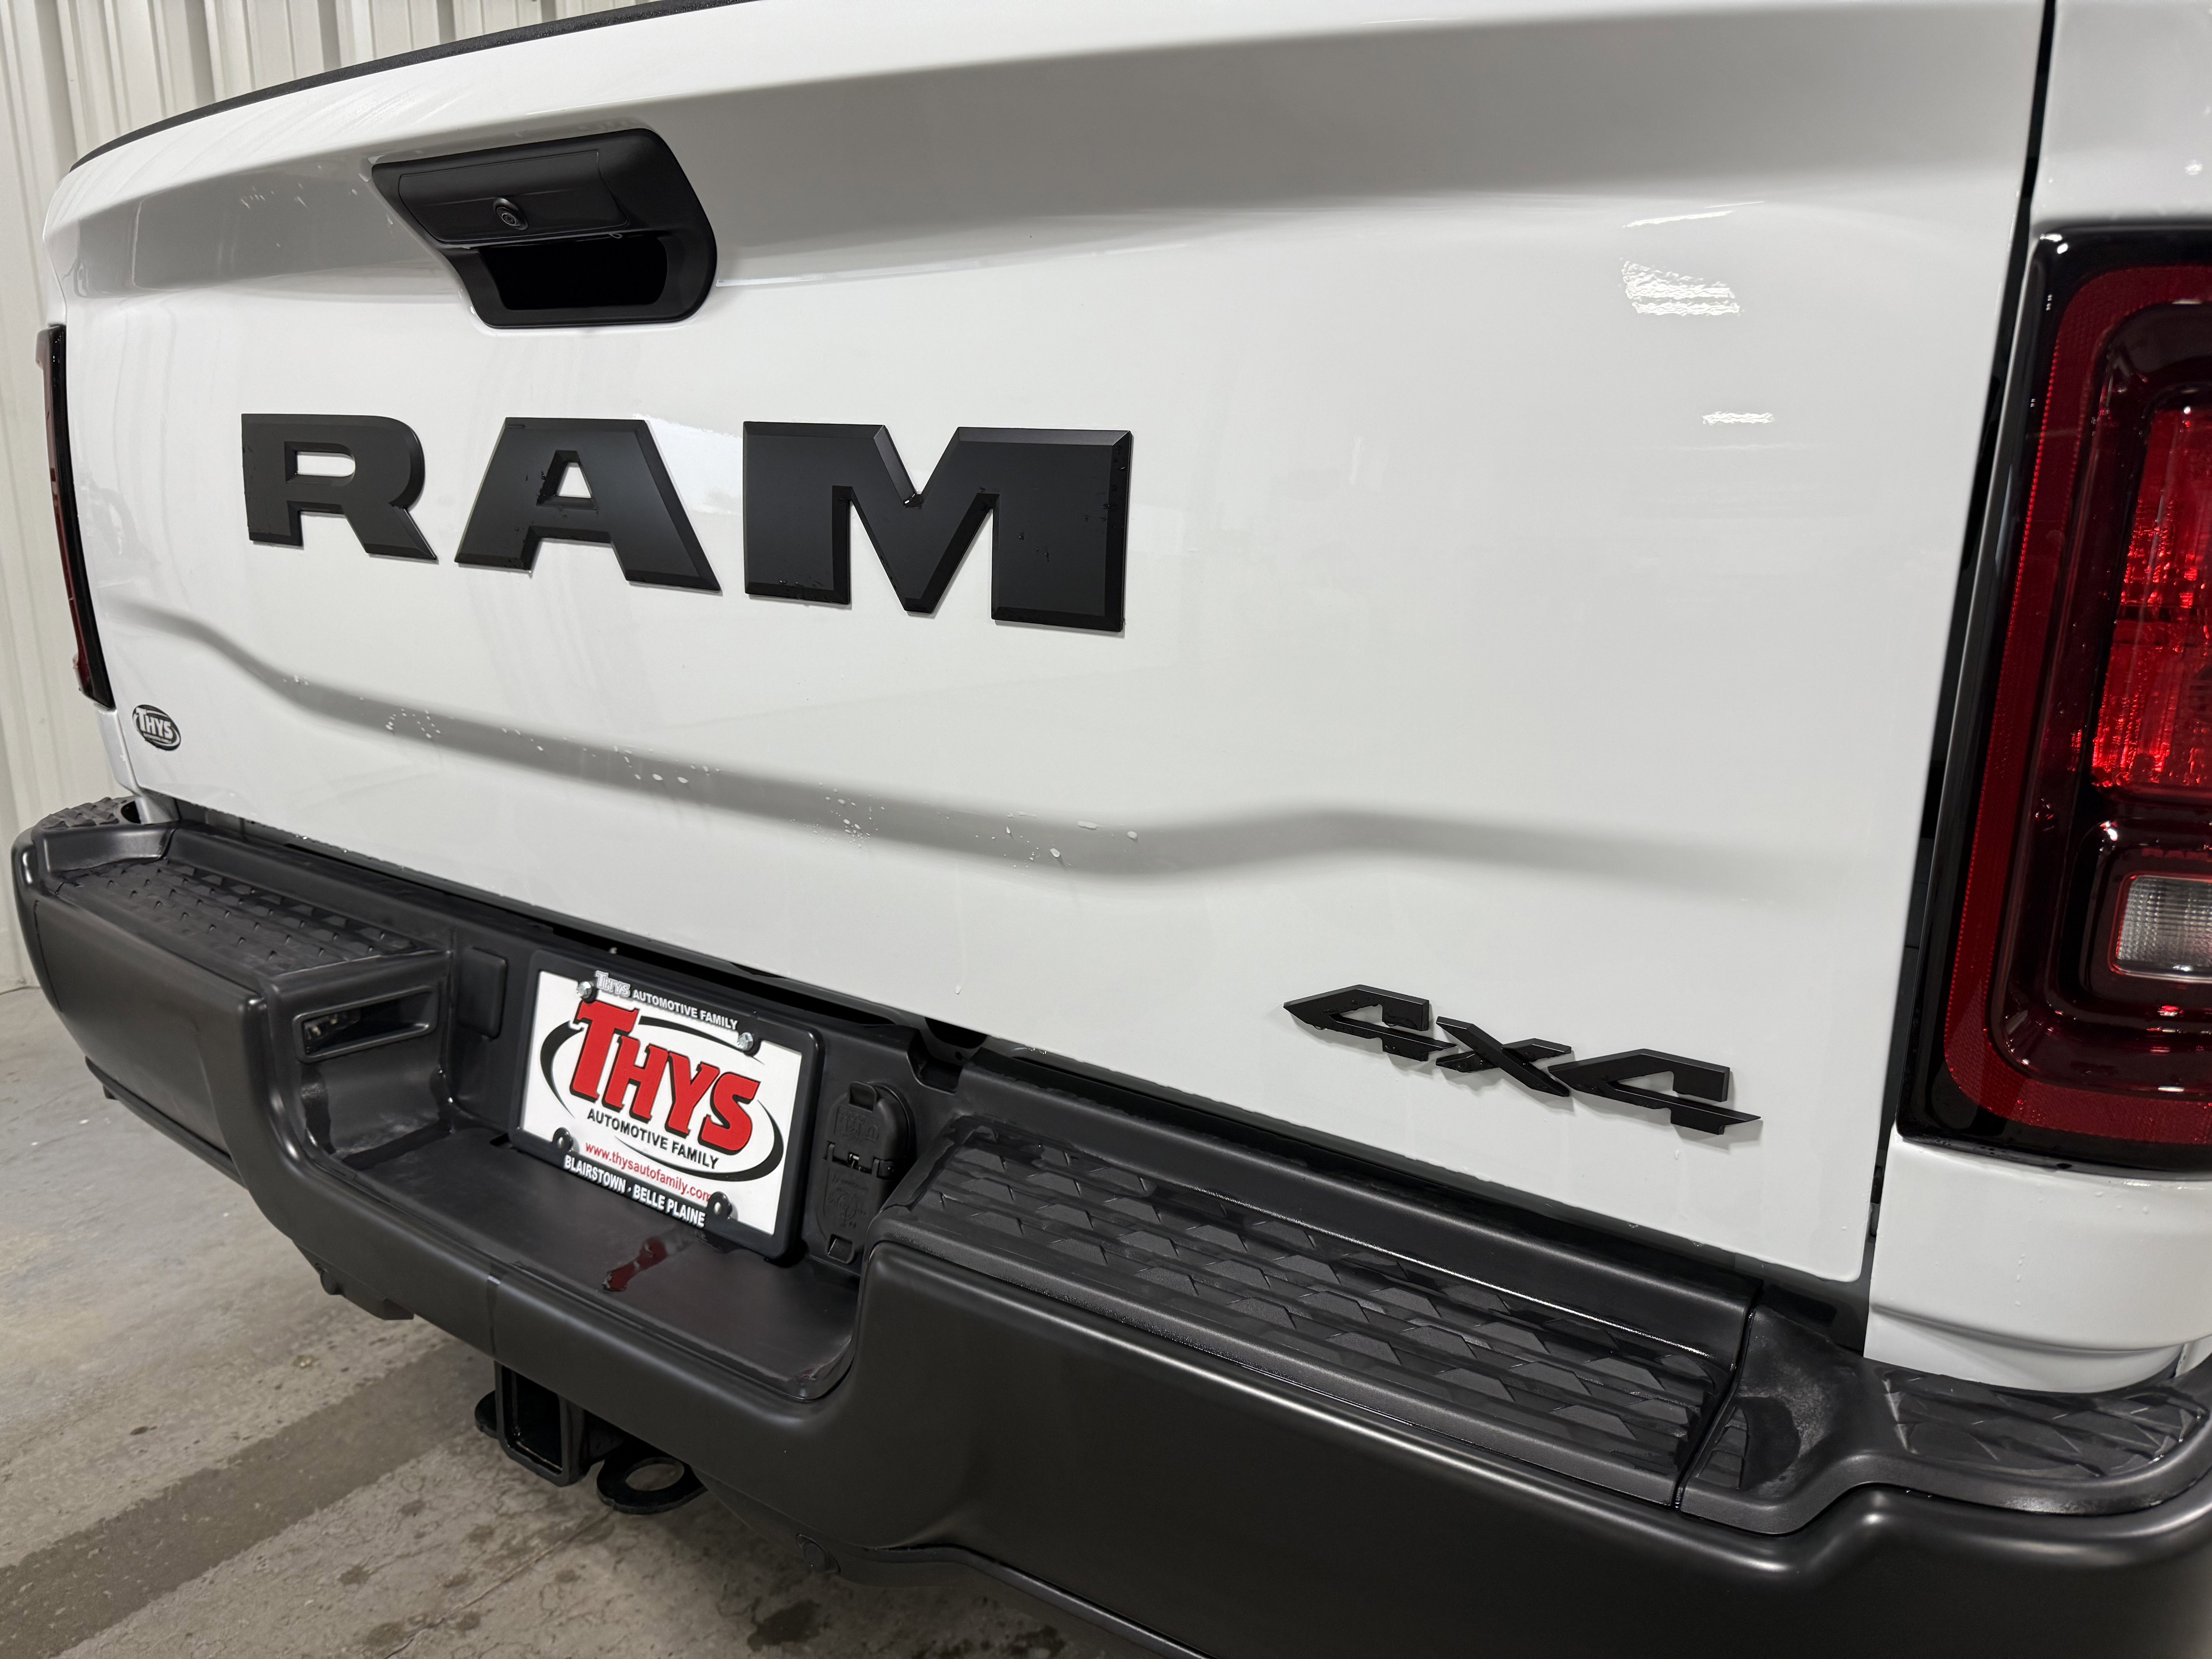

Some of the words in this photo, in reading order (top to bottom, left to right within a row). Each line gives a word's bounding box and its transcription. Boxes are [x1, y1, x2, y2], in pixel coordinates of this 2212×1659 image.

[241, 413, 1132, 633] RAM
[136, 707, 173, 740] THYS
[596, 970, 630, 997] THYS
[632, 989, 698, 1018] AUTOMOTIVE
[700, 1010, 738, 1030] FAMILY
[569, 1001, 762, 1156] THYS
[587, 1108, 668, 1151] AUTOMOTIVE
[672, 1142, 719, 1170] FAMILY
[563, 1155, 626, 1194] BLAIRSTOWN
[633, 1187, 666, 1211] BELLE
[667, 1202, 705, 1228] PLAINE
[585, 1142, 711, 1202] www.thysautofamily.com
